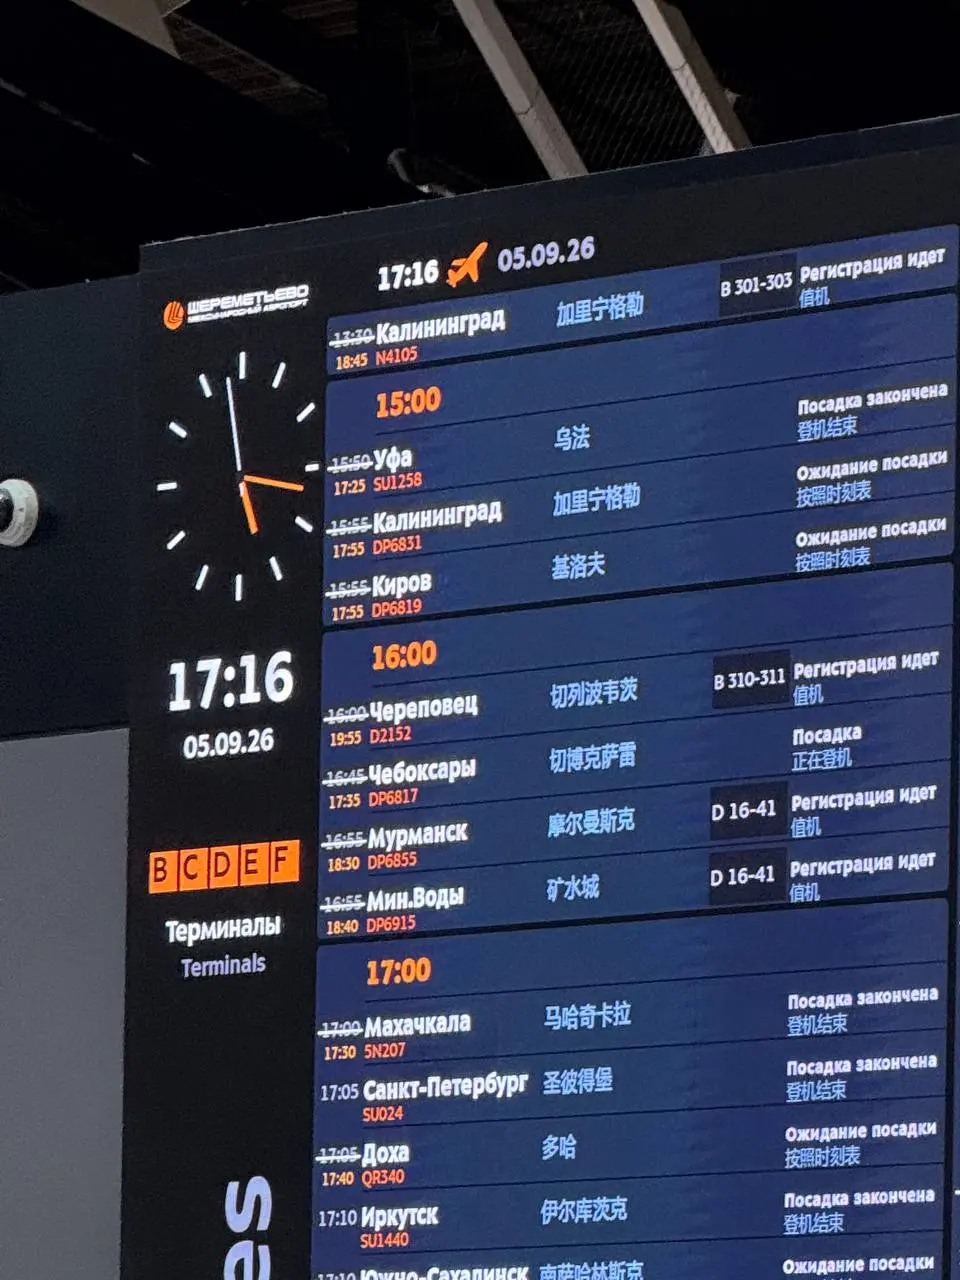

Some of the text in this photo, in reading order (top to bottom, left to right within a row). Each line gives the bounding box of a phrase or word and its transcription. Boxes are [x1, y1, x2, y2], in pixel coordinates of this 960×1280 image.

[378, 235, 595, 291] 17:16 05.09.26
[800, 248, 946, 284] Регистрация идет
[186, 282, 311, 315] ШЕРЕМЕТЬЕВО
[720, 271, 793, 298] B 301-303
[798, 286, 831, 309] 值机
[555, 290, 645, 328] 加里宁格勒
[375, 309, 506, 345] Калининград
[375, 346, 418, 365] N4105
[376, 385, 442, 418] 15:00
[797, 383, 949, 416] Посадка закончена
[796, 415, 858, 443] 登机结束
[373, 445, 413, 474] Уфа
[796, 450, 948, 482] Ожидание посадки
[374, 471, 423, 491] SU1258
[373, 500, 503, 535] Калининград
[372, 535, 421, 554] DP6831
[372, 572, 433, 599] Киров
[372, 639, 438, 671] 16:00
[169, 650, 294, 712] 17:16
[369, 694, 479, 726] Череповец
[183, 727, 275, 759] 05.09.26
[370, 725, 411, 744] D2152
[368, 758, 477, 786] Чебоксары
[368, 788, 417, 807] DP6817
[367, 822, 469, 853] Мурманск
[153, 846, 289, 883] B C D E F
[366, 886, 465, 913] Мин.Воды
[164, 915, 282, 947] Терминалы
[181, 952, 266, 978] Terminals
[367, 956, 432, 986] 17:00
[364, 1013, 472, 1039] Махачкала
[320, 1071, 529, 1102] 17:05 Санкт-Петербург
[542, 1066, 614, 1096] 圣彼得堡
[363, 1106, 404, 1121] SU024
[361, 1142, 410, 1168] Доха
[361, 1168, 405, 1188] QR340
[361, 1206, 439, 1232] Иркутск
